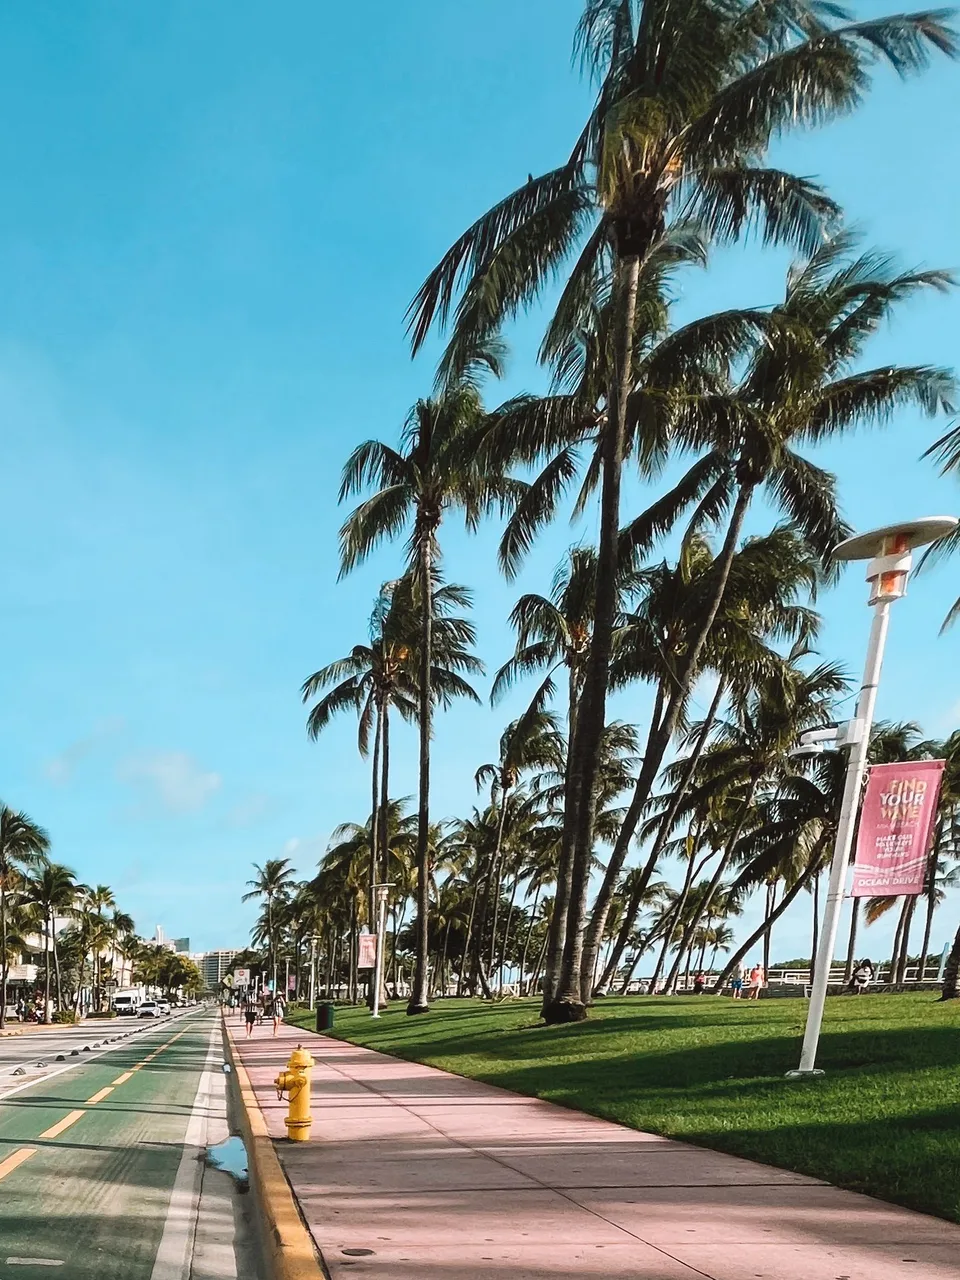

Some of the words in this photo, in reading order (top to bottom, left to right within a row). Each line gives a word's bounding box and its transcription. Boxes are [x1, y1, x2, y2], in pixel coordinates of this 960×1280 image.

[890, 778, 927, 794] FIND
[880, 793, 924, 807] YOUR
[881, 805, 920, 820] WAVE
[858, 878, 890, 887] OCEAN
[892, 876, 920, 885] DRIVE
